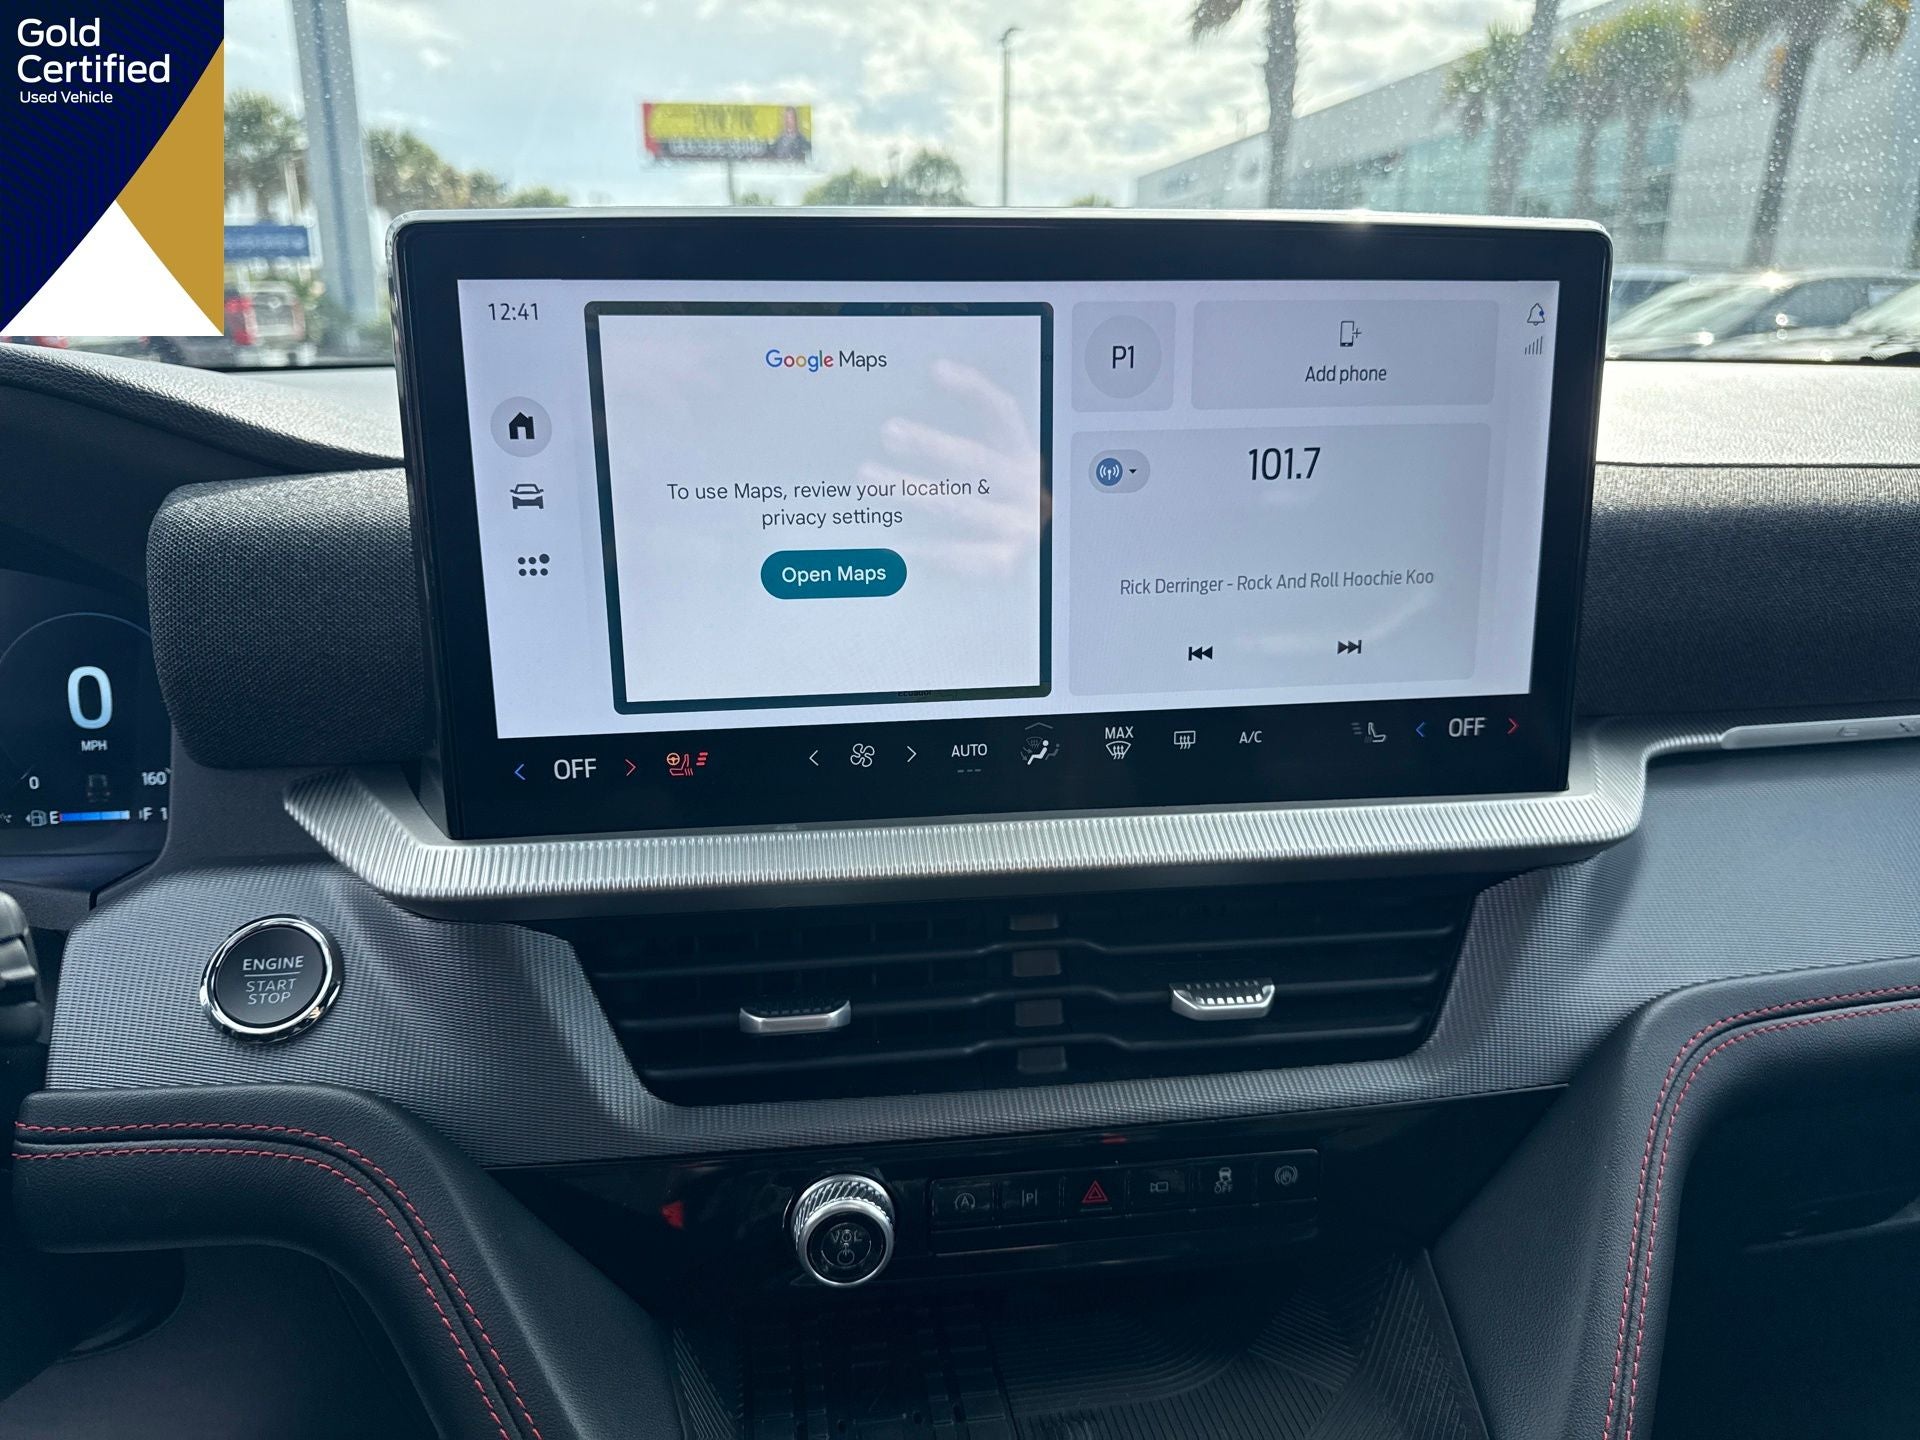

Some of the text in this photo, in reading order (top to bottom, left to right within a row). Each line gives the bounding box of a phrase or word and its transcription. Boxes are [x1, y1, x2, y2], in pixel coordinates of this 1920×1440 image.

[488, 302, 540, 322] 12:41
[765, 349, 888, 372] Google Maps
[1111, 345, 1136, 369] P1
[1305, 365, 1388, 385] Add phone
[1247, 446, 1322, 482] 101.7
[666, 478, 991, 503] To use Maps, review your location &
[761, 505, 904, 530] privacy settings
[781, 562, 888, 587] Open Maps
[1120, 577, 1151, 596] Rick
[1154, 575, 1223, 597] Derringer
[1236, 574, 1273, 592] Rock
[1276, 573, 1307, 590] And
[1310, 572, 1340, 590] Roll
[1342, 570, 1403, 588] Hoochie
[1406, 569, 1435, 587] Koo
[67, 665, 113, 730] 0
[1104, 726, 1134, 741] MAX
[1448, 717, 1486, 737] OFF
[80, 739, 108, 752] MPH
[1238, 730, 1263, 745] A/C
[951, 743, 988, 759] AUTO
[141, 771, 167, 786] 160
[553, 757, 597, 781] OFF
[28, 775, 40, 790] 0
[49, 811, 60, 825] E
[242, 955, 305, 971] ENGINE
[245, 978, 297, 993] START
[247, 992, 291, 1005] STOP
[831, 1228, 862, 1243] VOL
